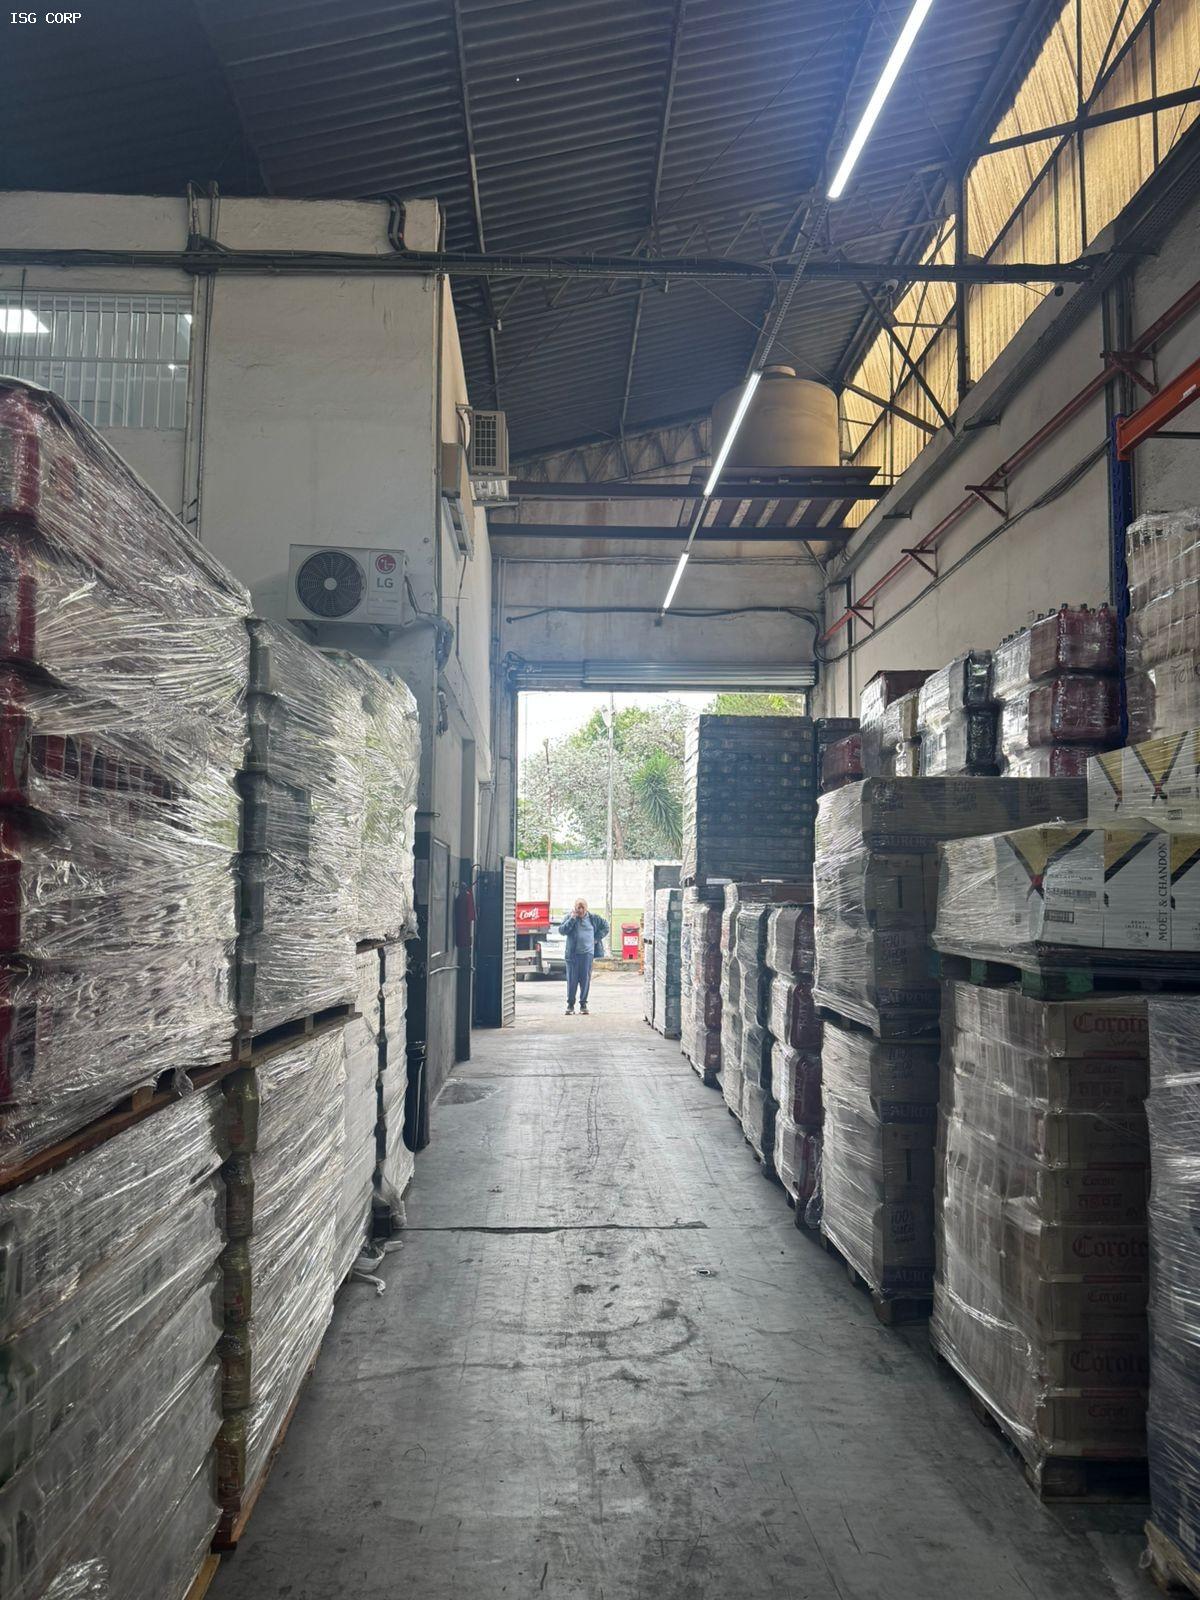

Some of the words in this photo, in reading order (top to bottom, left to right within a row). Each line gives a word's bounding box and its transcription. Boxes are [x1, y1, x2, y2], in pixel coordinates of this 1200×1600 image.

[376, 578, 394, 588] LG
[1158, 842, 1168, 898] CHANDON
[1158, 898, 1168, 908] &
